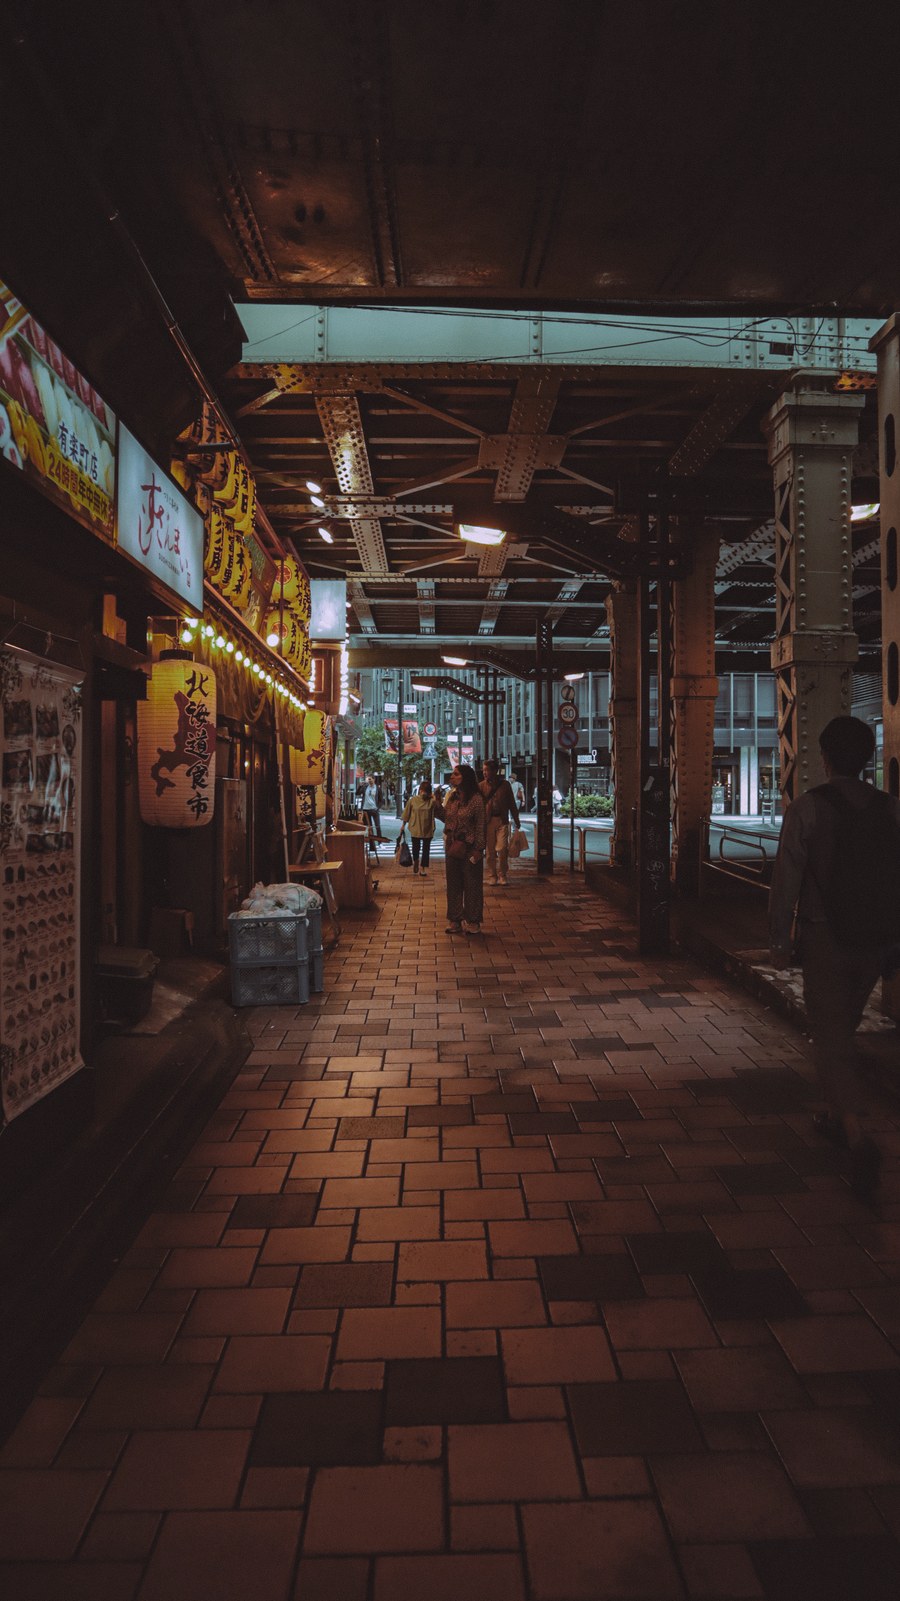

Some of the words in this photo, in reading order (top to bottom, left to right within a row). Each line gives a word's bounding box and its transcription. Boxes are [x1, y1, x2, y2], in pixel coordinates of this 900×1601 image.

[58, 421, 98, 481] 有楽町店
[562, 708, 575, 719] 30
[184, 669, 210, 821] 北海道食市
